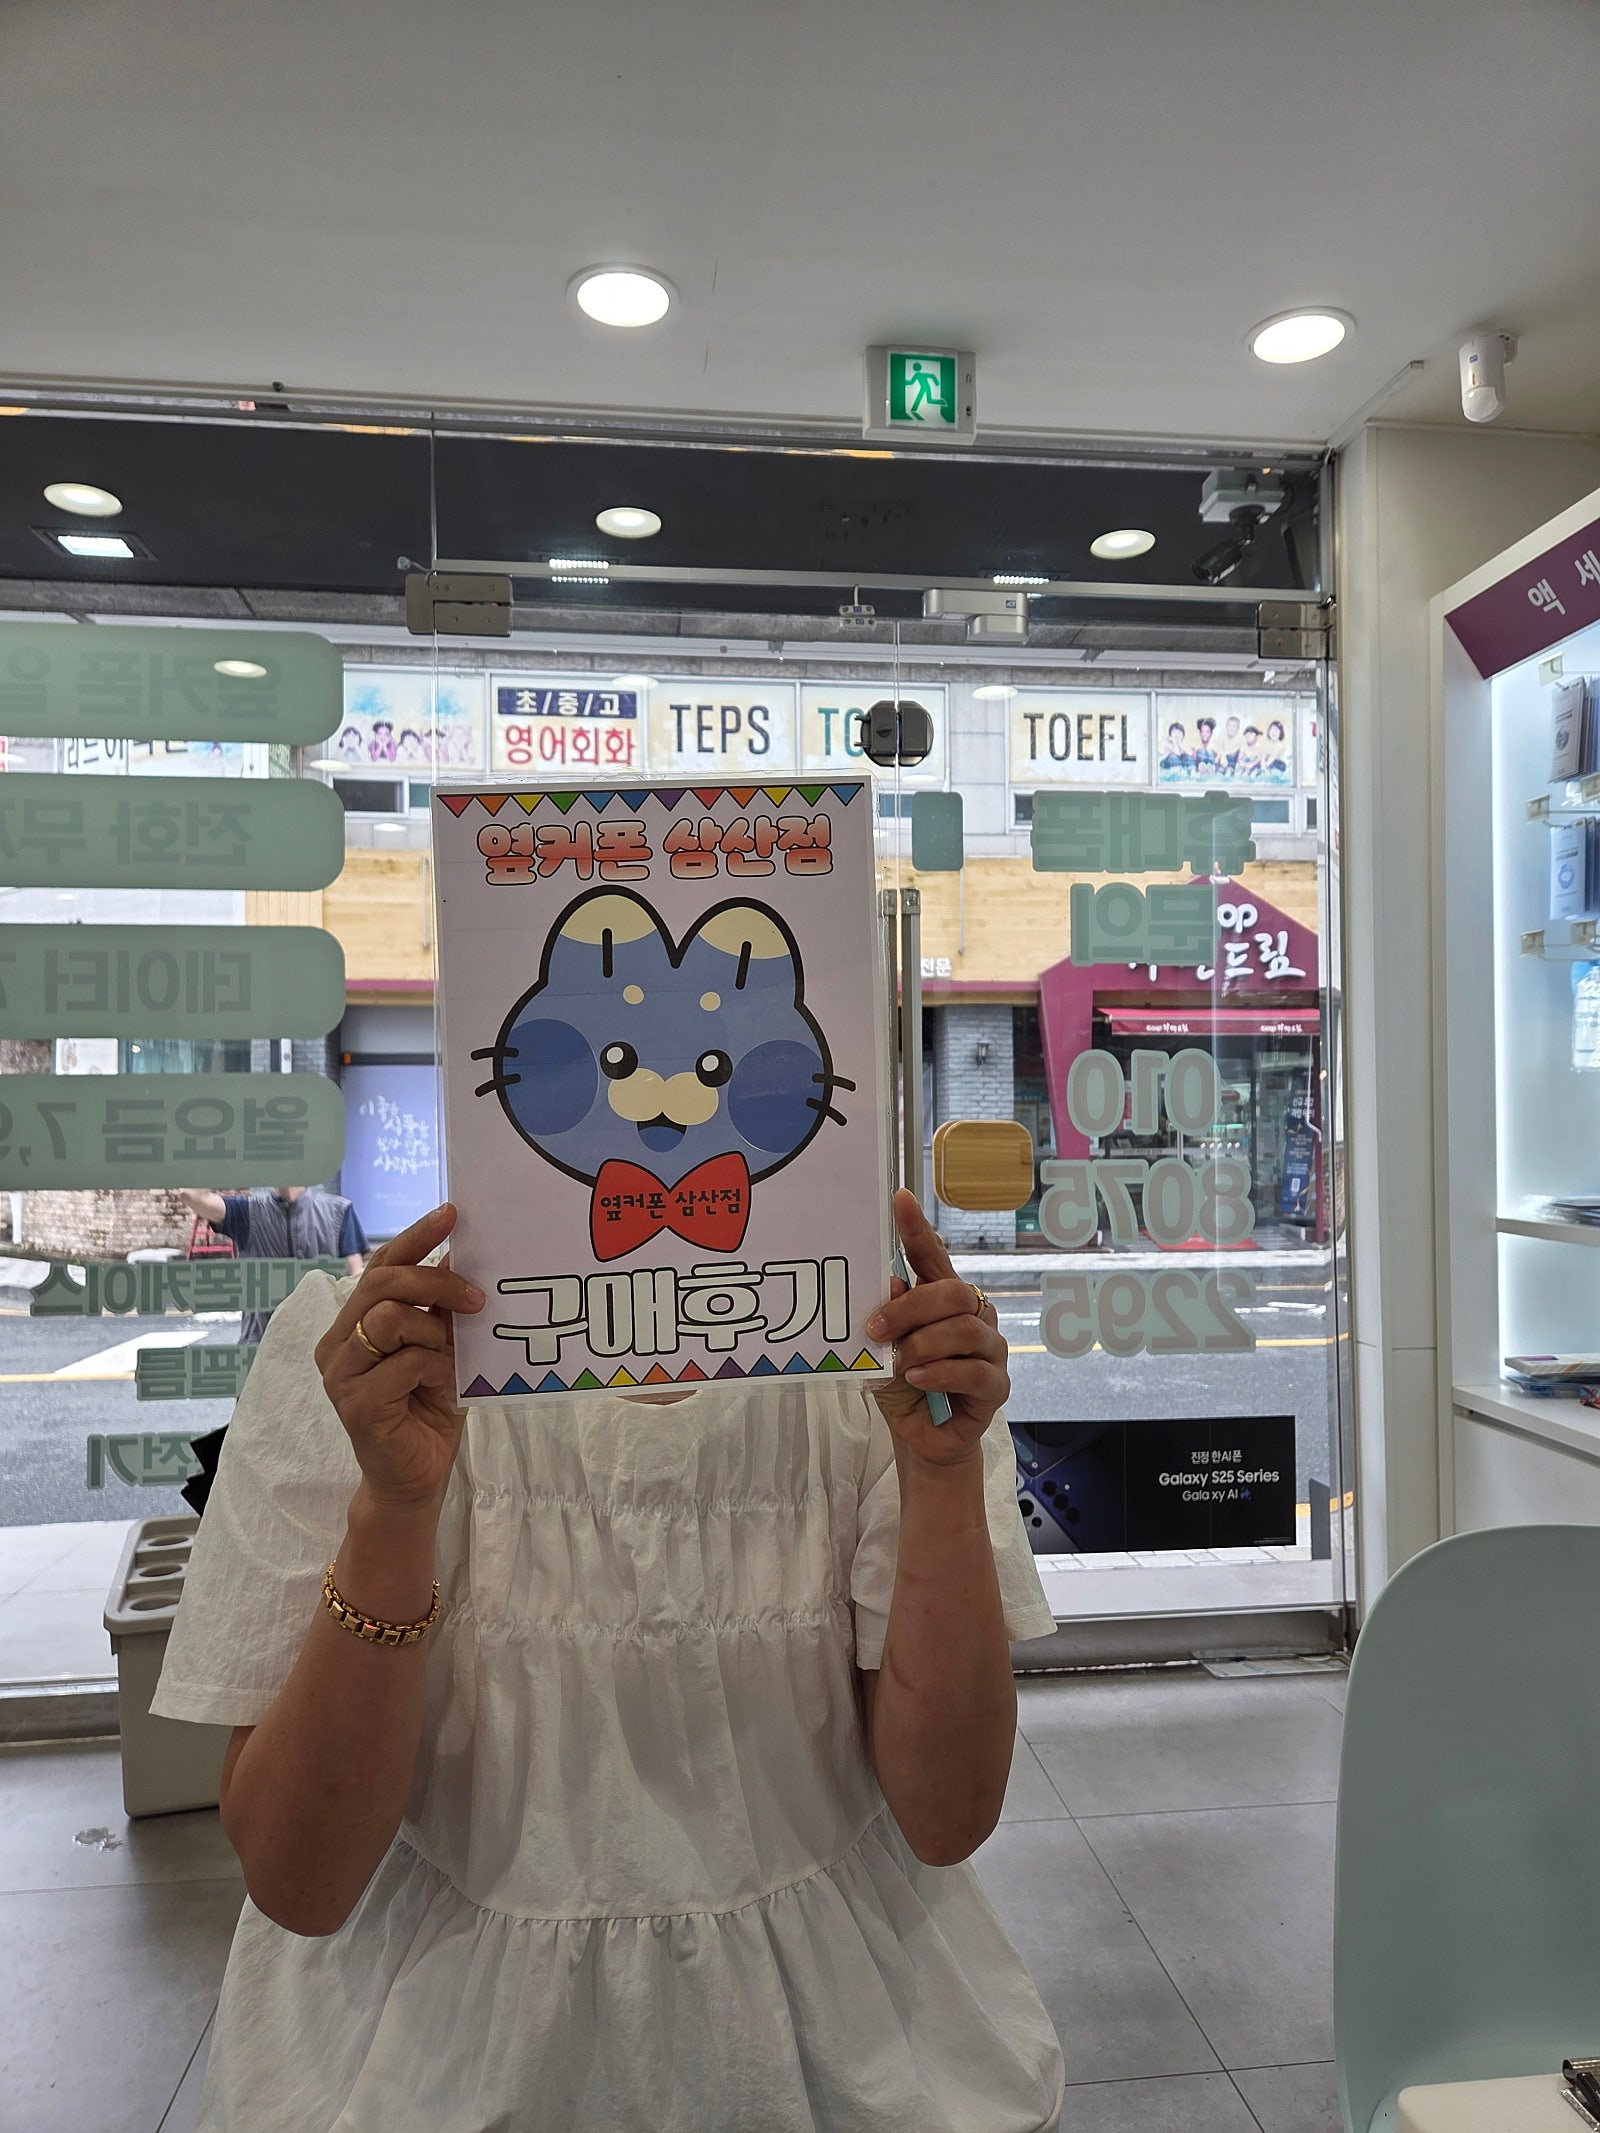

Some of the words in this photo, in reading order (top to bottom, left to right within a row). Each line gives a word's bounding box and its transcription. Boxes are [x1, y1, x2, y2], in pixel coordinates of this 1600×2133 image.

[515, 690, 622, 716] 초/중/고
[505, 724, 635, 766] 영어회화
[670, 704, 770, 755] TEPS
[1023, 712, 1137, 762] TOEFL
[477, 820, 653, 885] 옆커폰
[663, 814, 833, 879] 삼산점
[600, 1191, 666, 1222] 옆커폰
[674, 1188, 742, 1217] 삼산점
[493, 1255, 850, 1366] 구매후기
[1159, 1471, 1209, 1487] Galaxy
[1211, 1470, 1235, 1484] S25
[1236, 1468, 1280, 1483] Series
[1182, 1489, 1226, 1503] Galaxy
[1227, 1488, 1239, 1499] AI
